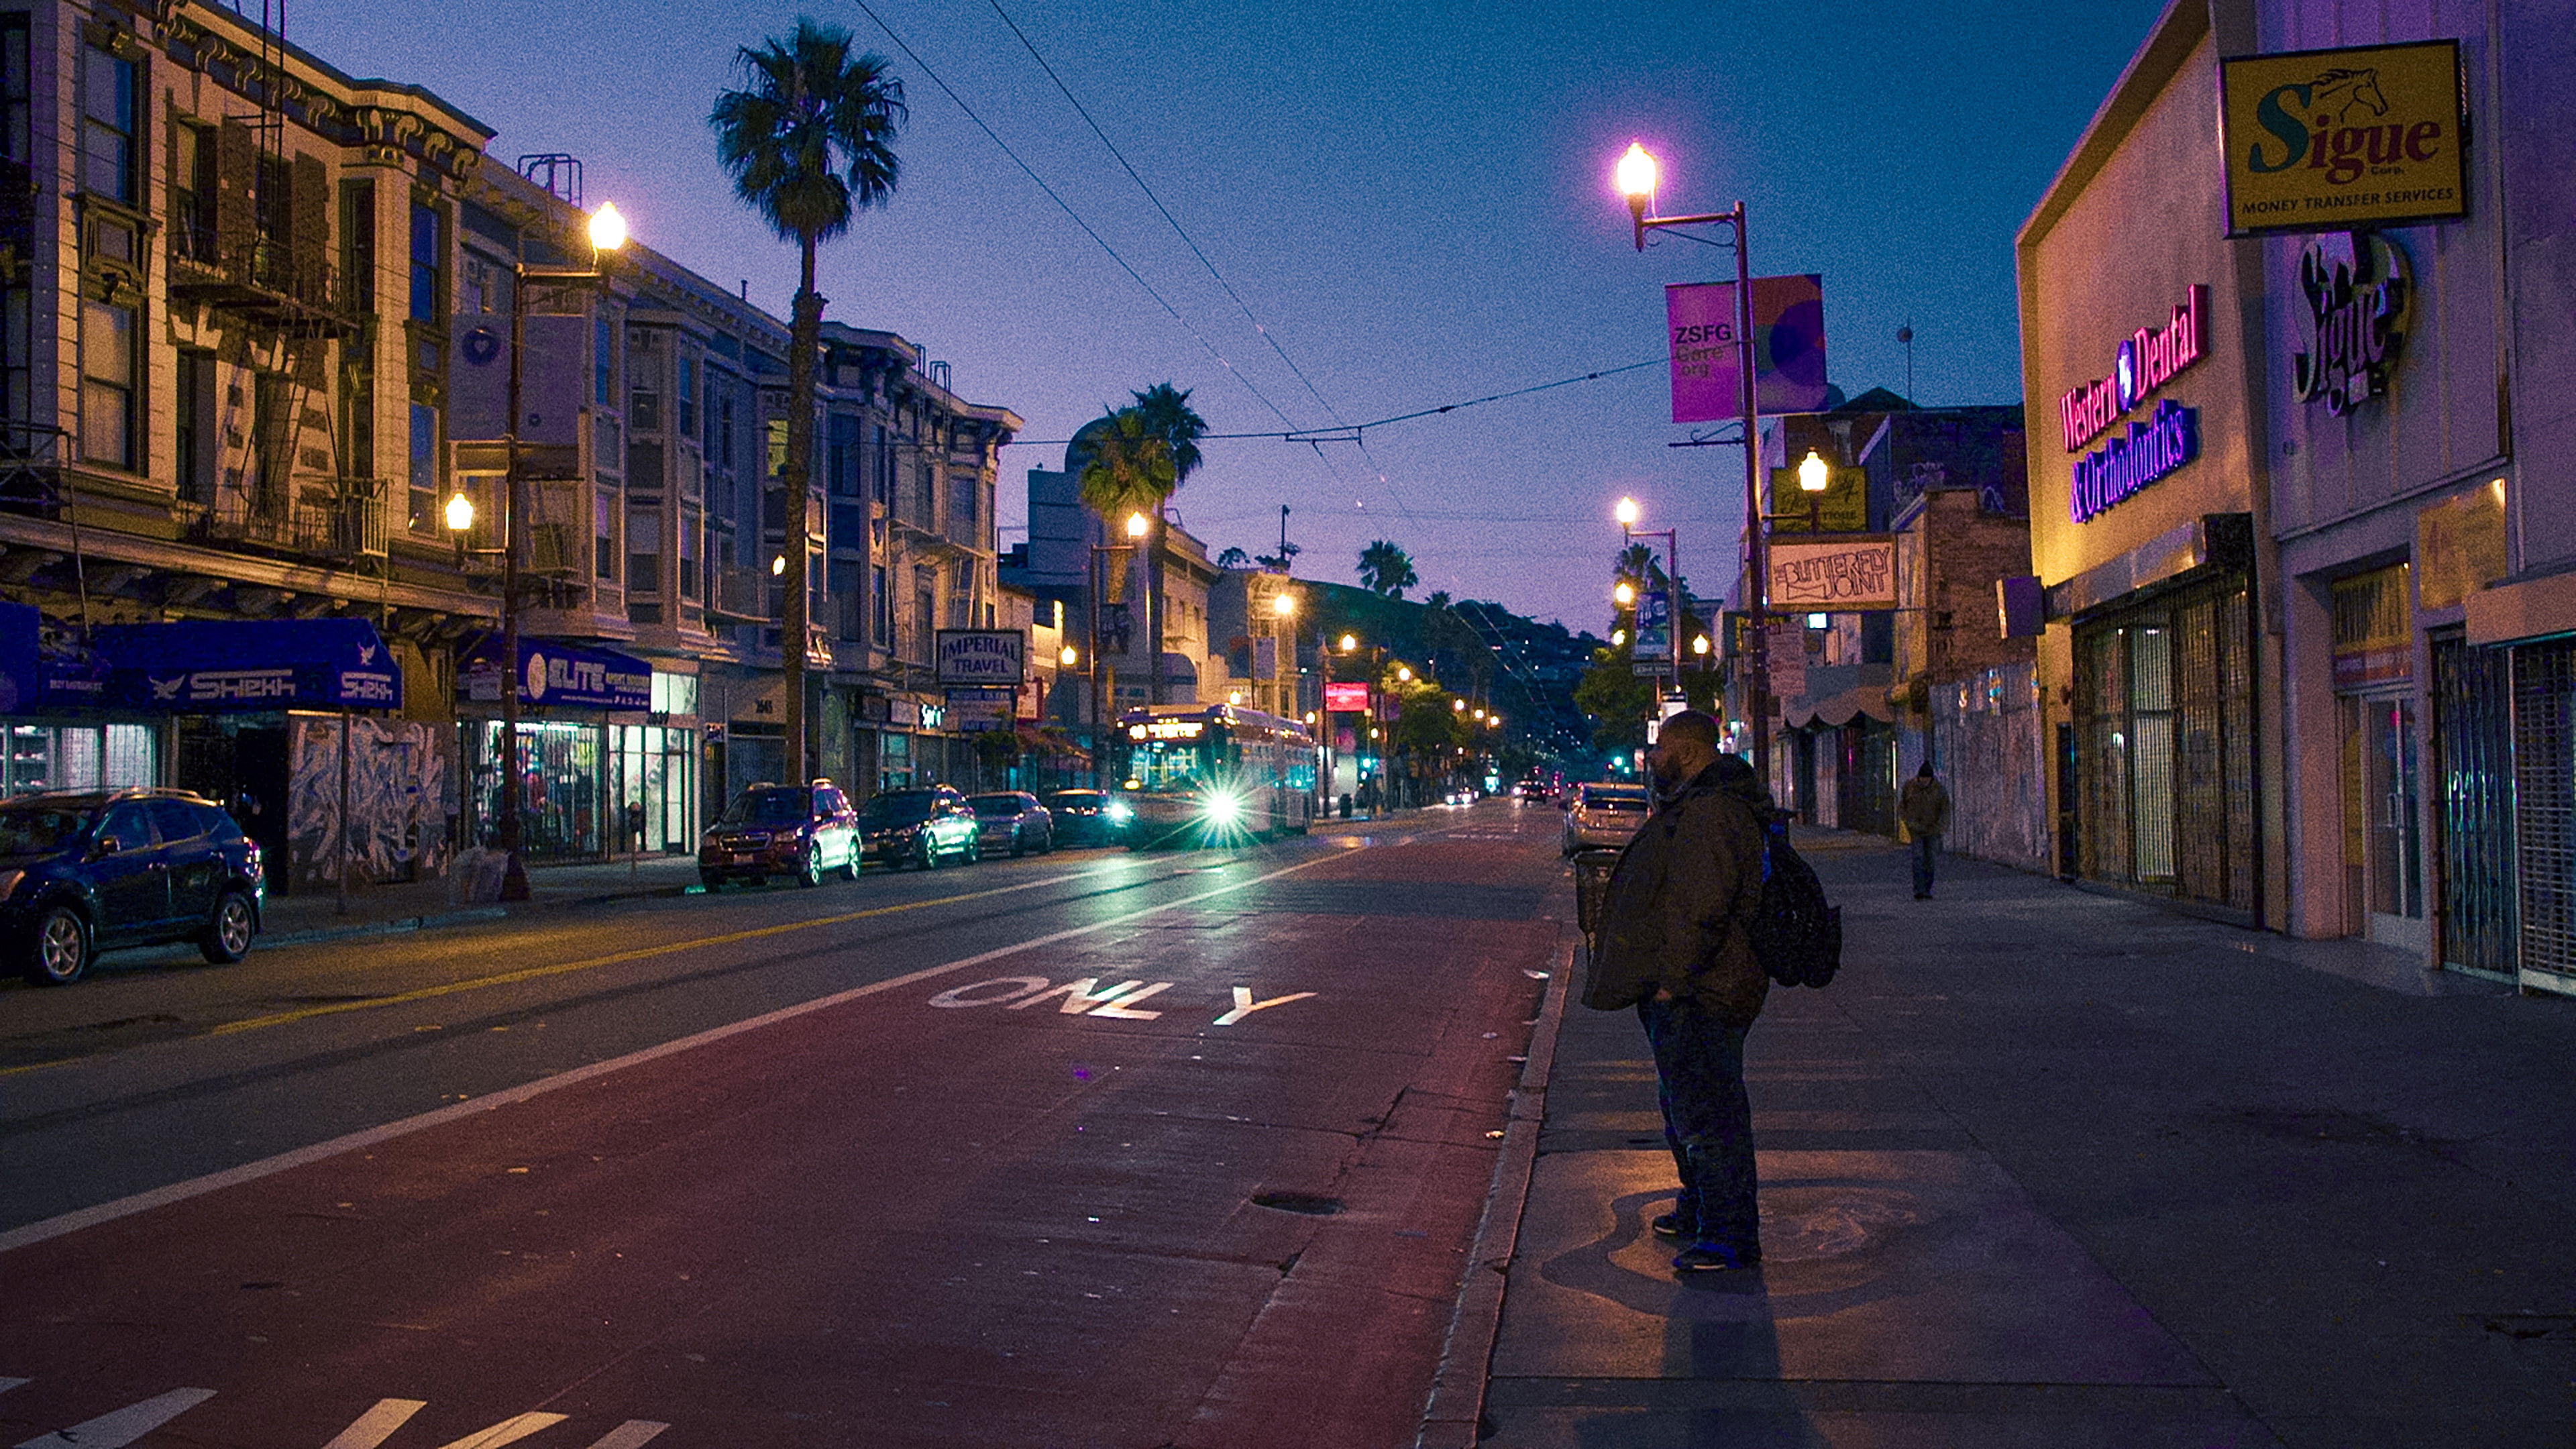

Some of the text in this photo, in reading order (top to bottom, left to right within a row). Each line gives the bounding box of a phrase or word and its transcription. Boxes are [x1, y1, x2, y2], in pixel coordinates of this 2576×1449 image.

[2248, 83, 2442, 184] Sigue
[2241, 188, 2454, 214] MONEY TRANSFER SERVICES
[1675, 323, 1731, 344] ZSFG
[1676, 345, 1724, 362] Care
[2059, 284, 2208, 453] Western Dental
[2070, 400, 2197, 525] & Orthodontics
[1784, 547, 1890, 585] BUTTERFLY
[1825, 572, 1886, 599] JOINT
[942, 637, 1018, 661] IMPERIAL
[548, 657, 606, 693] ELITE
[953, 659, 1009, 674] TRAVEL
[928, 975, 1318, 1026] ONLY
